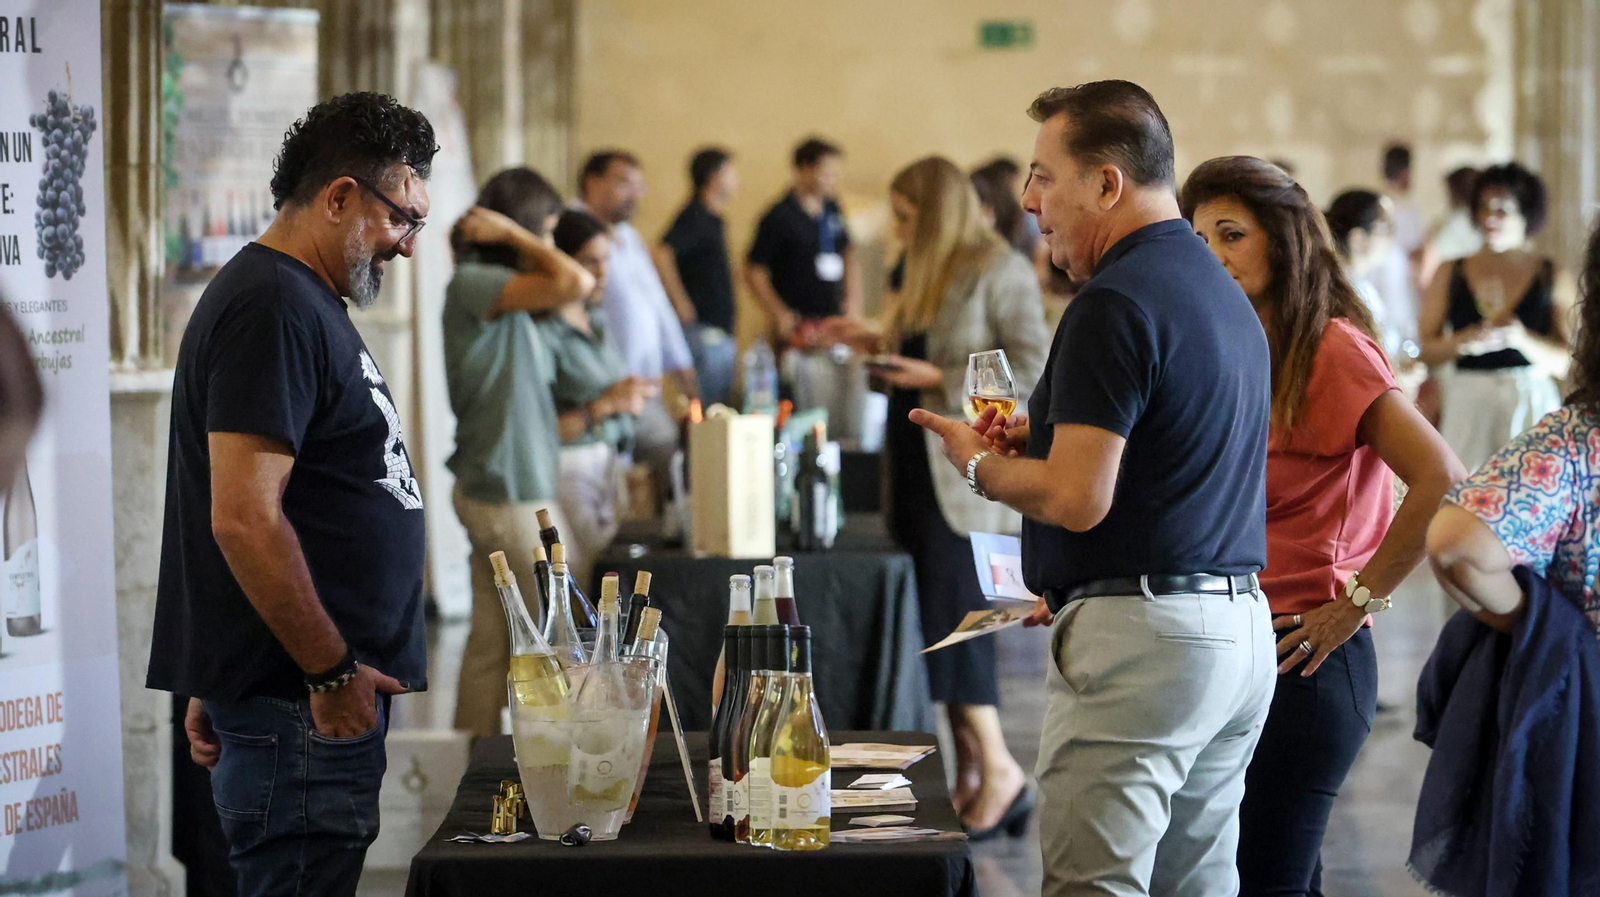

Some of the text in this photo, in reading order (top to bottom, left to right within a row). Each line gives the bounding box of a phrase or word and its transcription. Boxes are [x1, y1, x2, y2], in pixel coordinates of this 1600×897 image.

[13, 132, 32, 162] UN
[0, 183, 14, 214] E:
[20, 299, 68, 314] ELEGANTES
[29, 323, 85, 345] Ancestral
[46, 691, 63, 724] DE
[4, 802, 23, 836] DE
[26, 787, 80, 832] ESPAÑA
